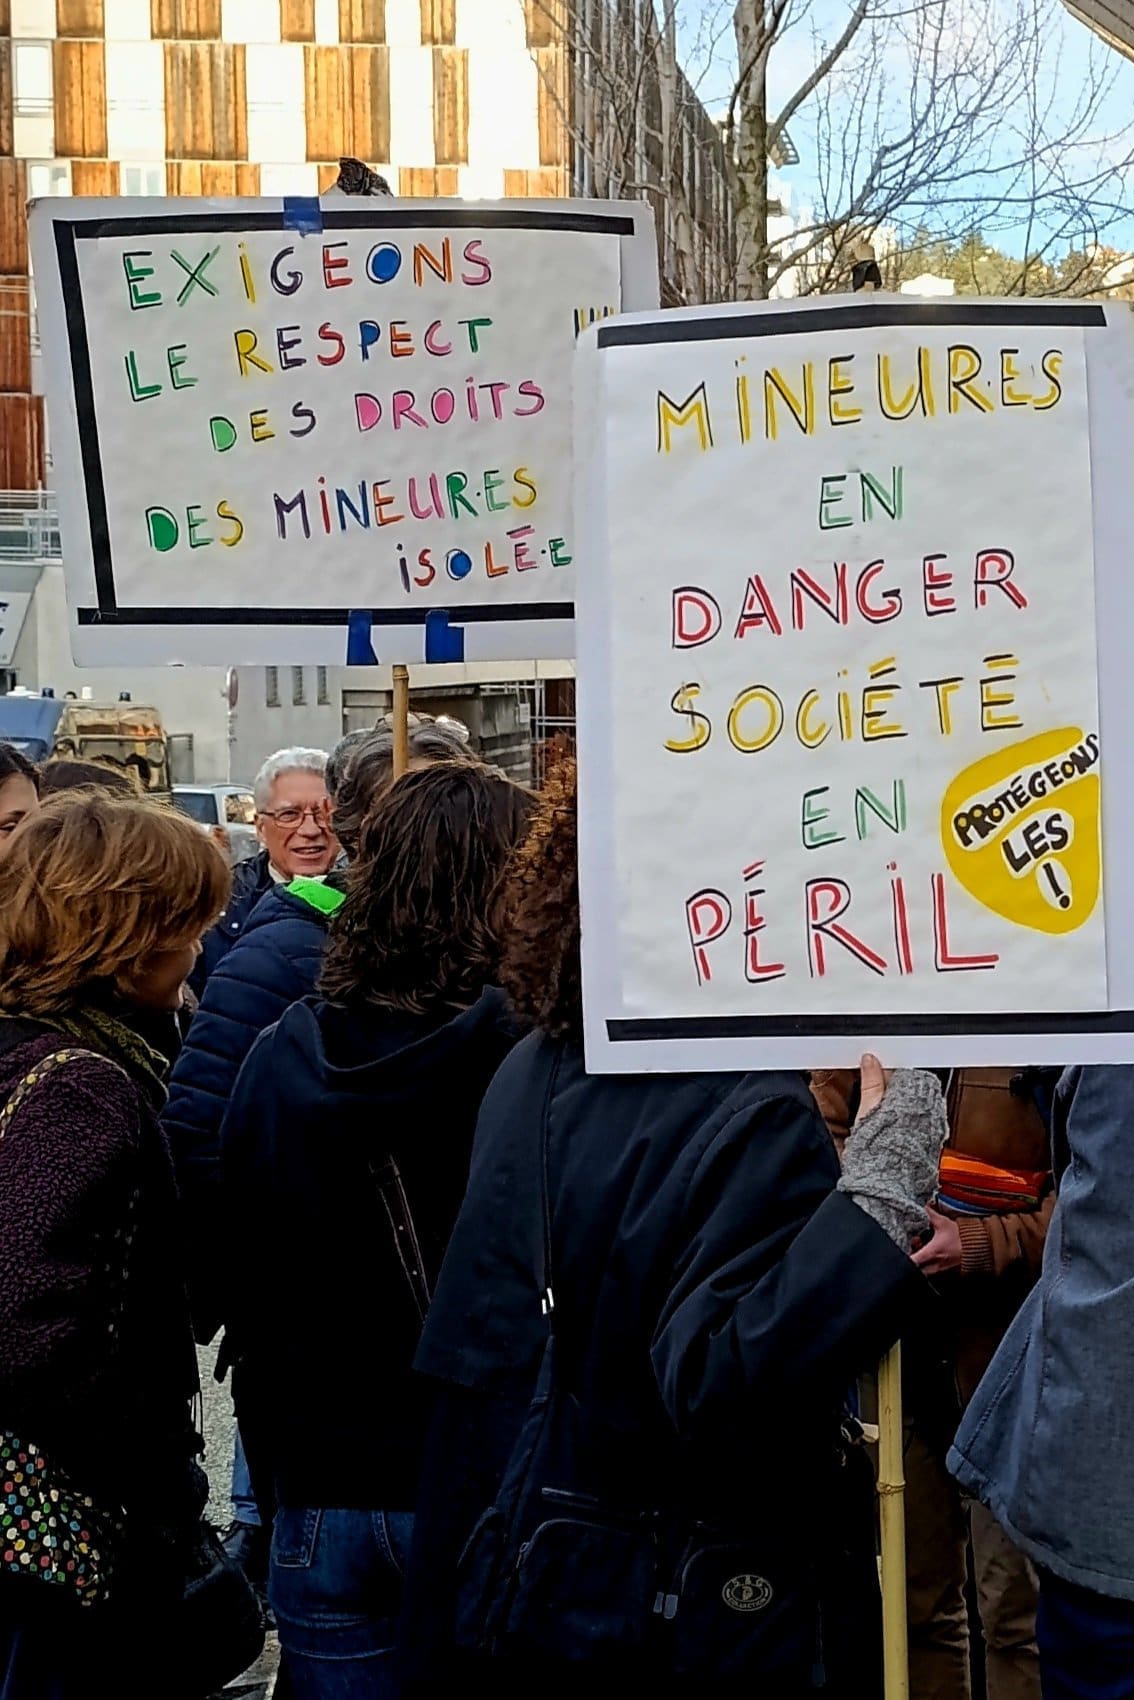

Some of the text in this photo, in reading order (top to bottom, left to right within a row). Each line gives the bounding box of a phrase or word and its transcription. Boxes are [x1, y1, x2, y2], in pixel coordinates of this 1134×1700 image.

[122, 237, 494, 310] EXIGEONS
[125, 318, 493, 402] LE RESPECT
[210, 377, 544, 452] DES DROITS
[145, 500, 243, 552] DES
[819, 467, 902, 530] EN
[672, 548, 1028, 649] DANGER
[663, 654, 1024, 754] SOCIÉTÉ
[802, 779, 906, 850] EN
[953, 733, 1099, 847] PROTÉGEONS
[1002, 813, 1069, 873] LES
[1043, 862, 1070, 909] !
[686, 860, 1000, 986] PÉRIL
